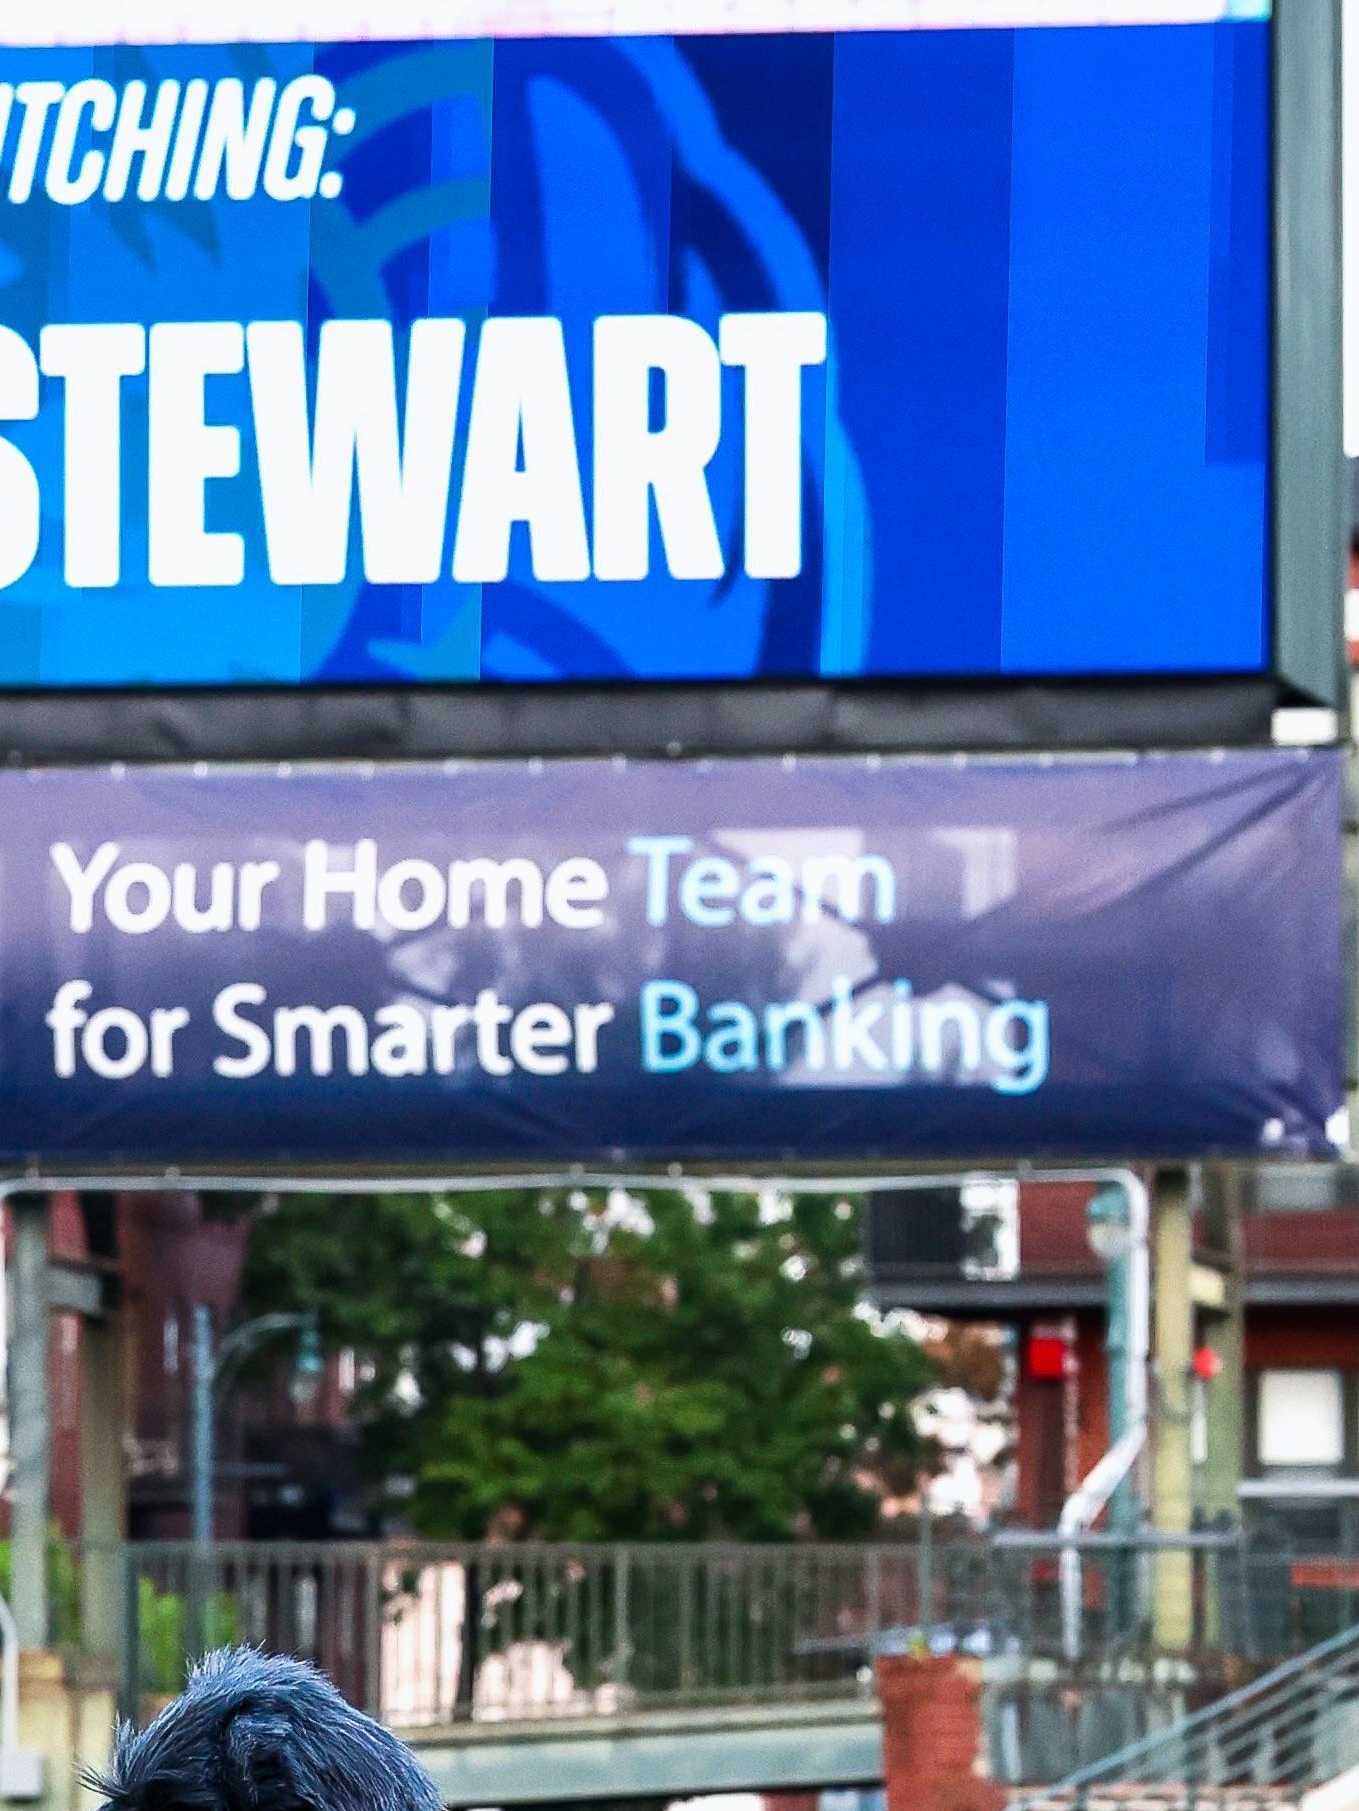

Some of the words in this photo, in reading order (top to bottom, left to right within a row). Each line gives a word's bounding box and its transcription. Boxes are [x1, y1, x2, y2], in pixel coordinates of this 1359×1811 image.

[48, 840, 280, 935] Your
[303, 838, 610, 930] Home
[627, 836, 895, 926] Team
[46, 979, 190, 1078] for
[213, 982, 614, 1078] Smarter
[643, 977, 1050, 1095] Banking
